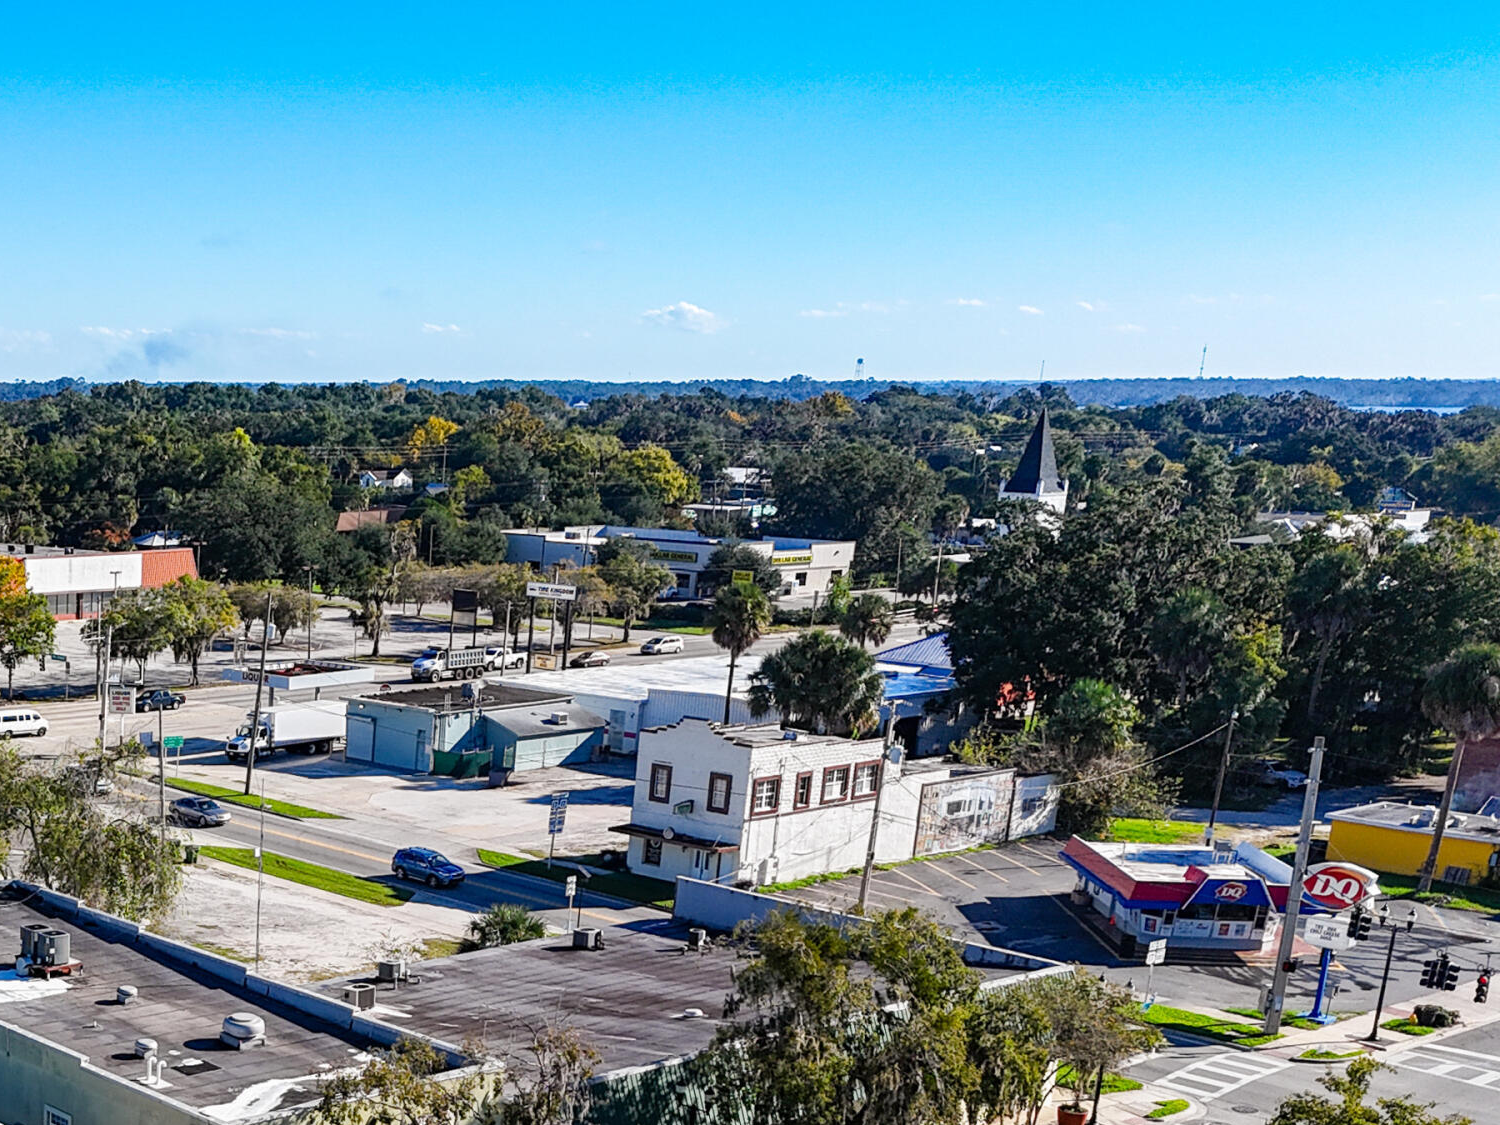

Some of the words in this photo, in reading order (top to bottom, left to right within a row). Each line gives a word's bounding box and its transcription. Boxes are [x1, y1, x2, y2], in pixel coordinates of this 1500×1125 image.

[242, 671, 269, 683] LIQUR
[1220, 887, 1243, 899] DQ
[1310, 873, 1360, 905] DQ
